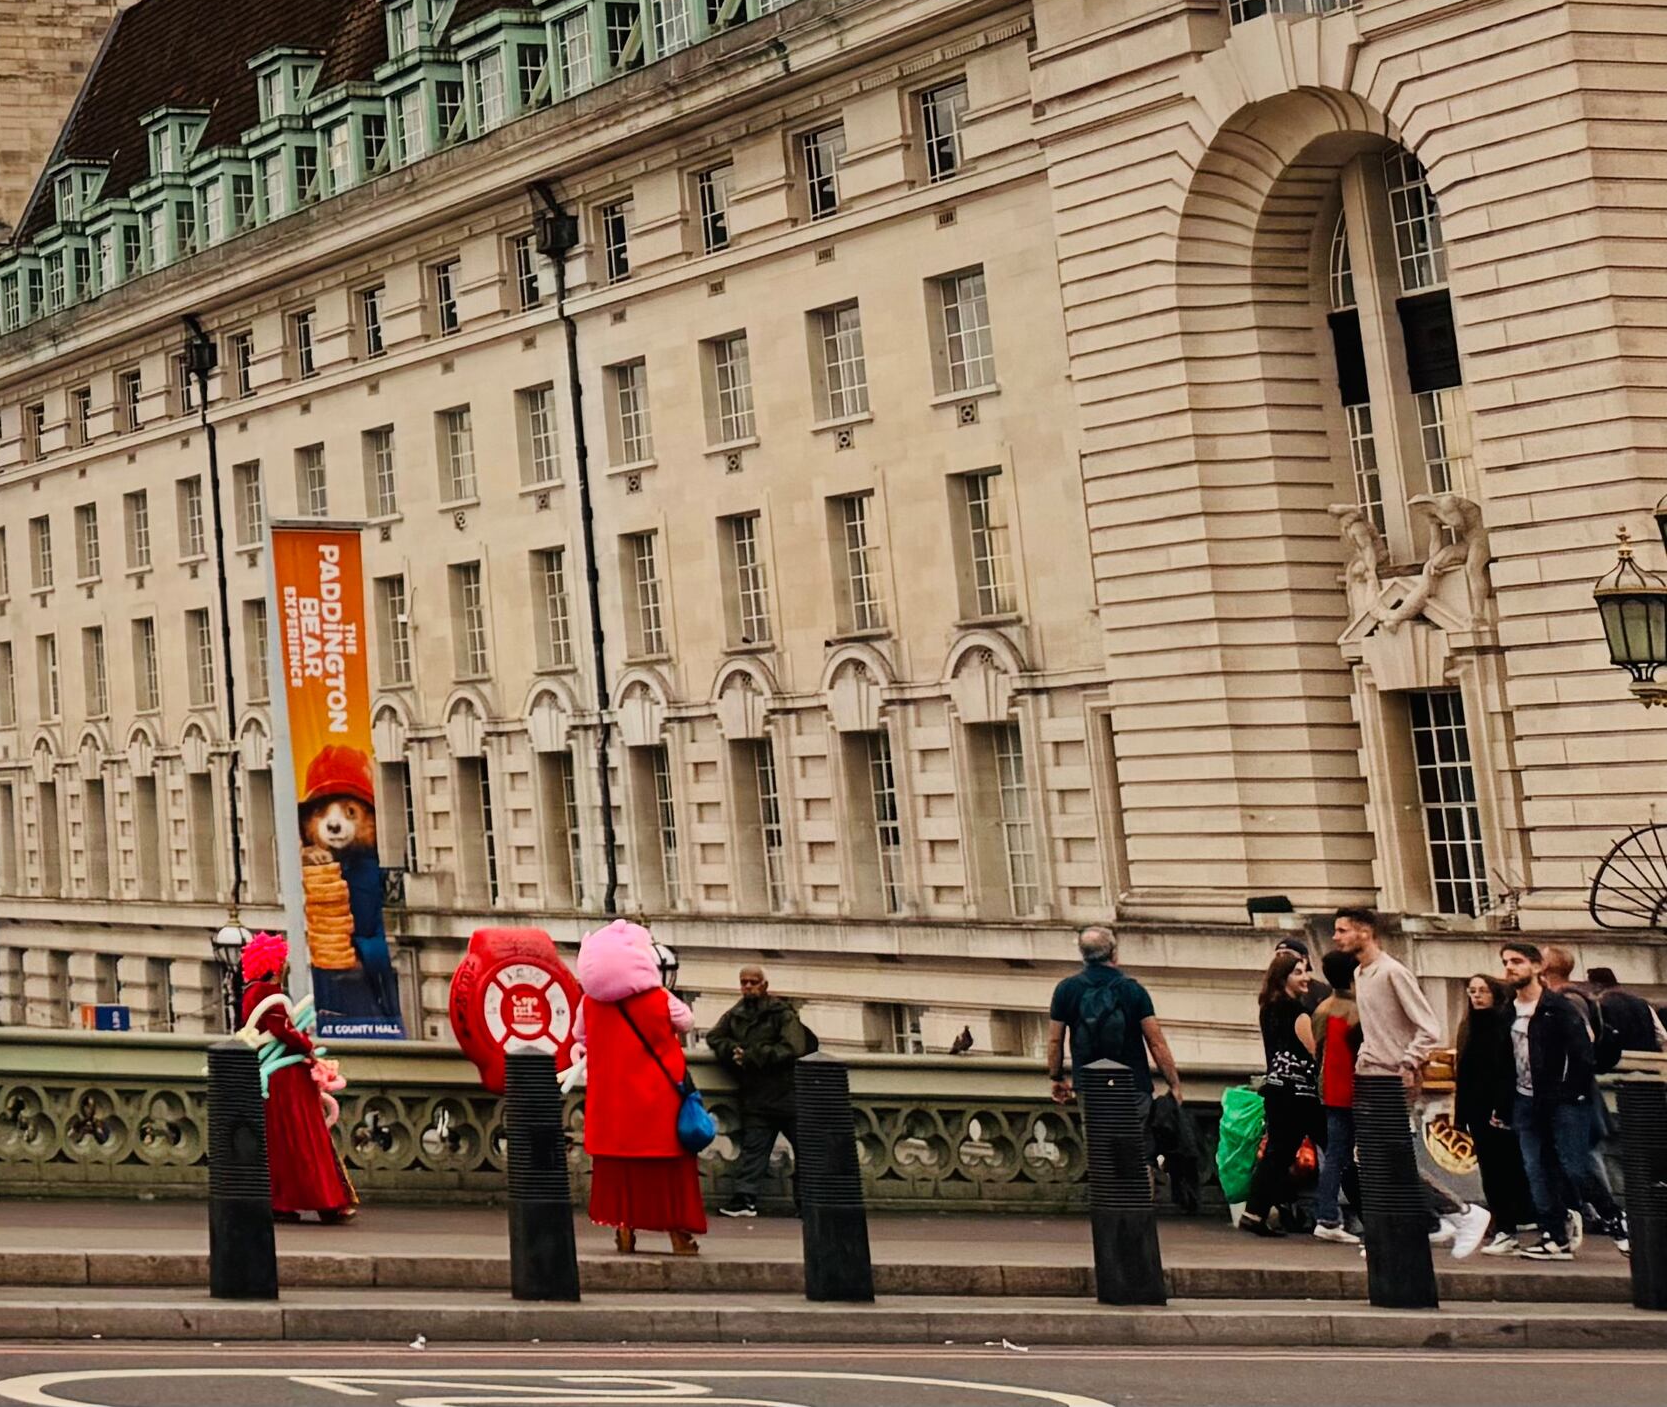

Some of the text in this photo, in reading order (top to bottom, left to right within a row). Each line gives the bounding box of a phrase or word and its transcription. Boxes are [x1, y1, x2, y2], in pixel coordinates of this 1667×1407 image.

[283, 586, 303, 688] EXPERIENCE
[299, 597, 324, 678] BEAR
[344, 622, 357, 655] THE
[321, 1024, 401, 1035] AT COUNTY HALL
